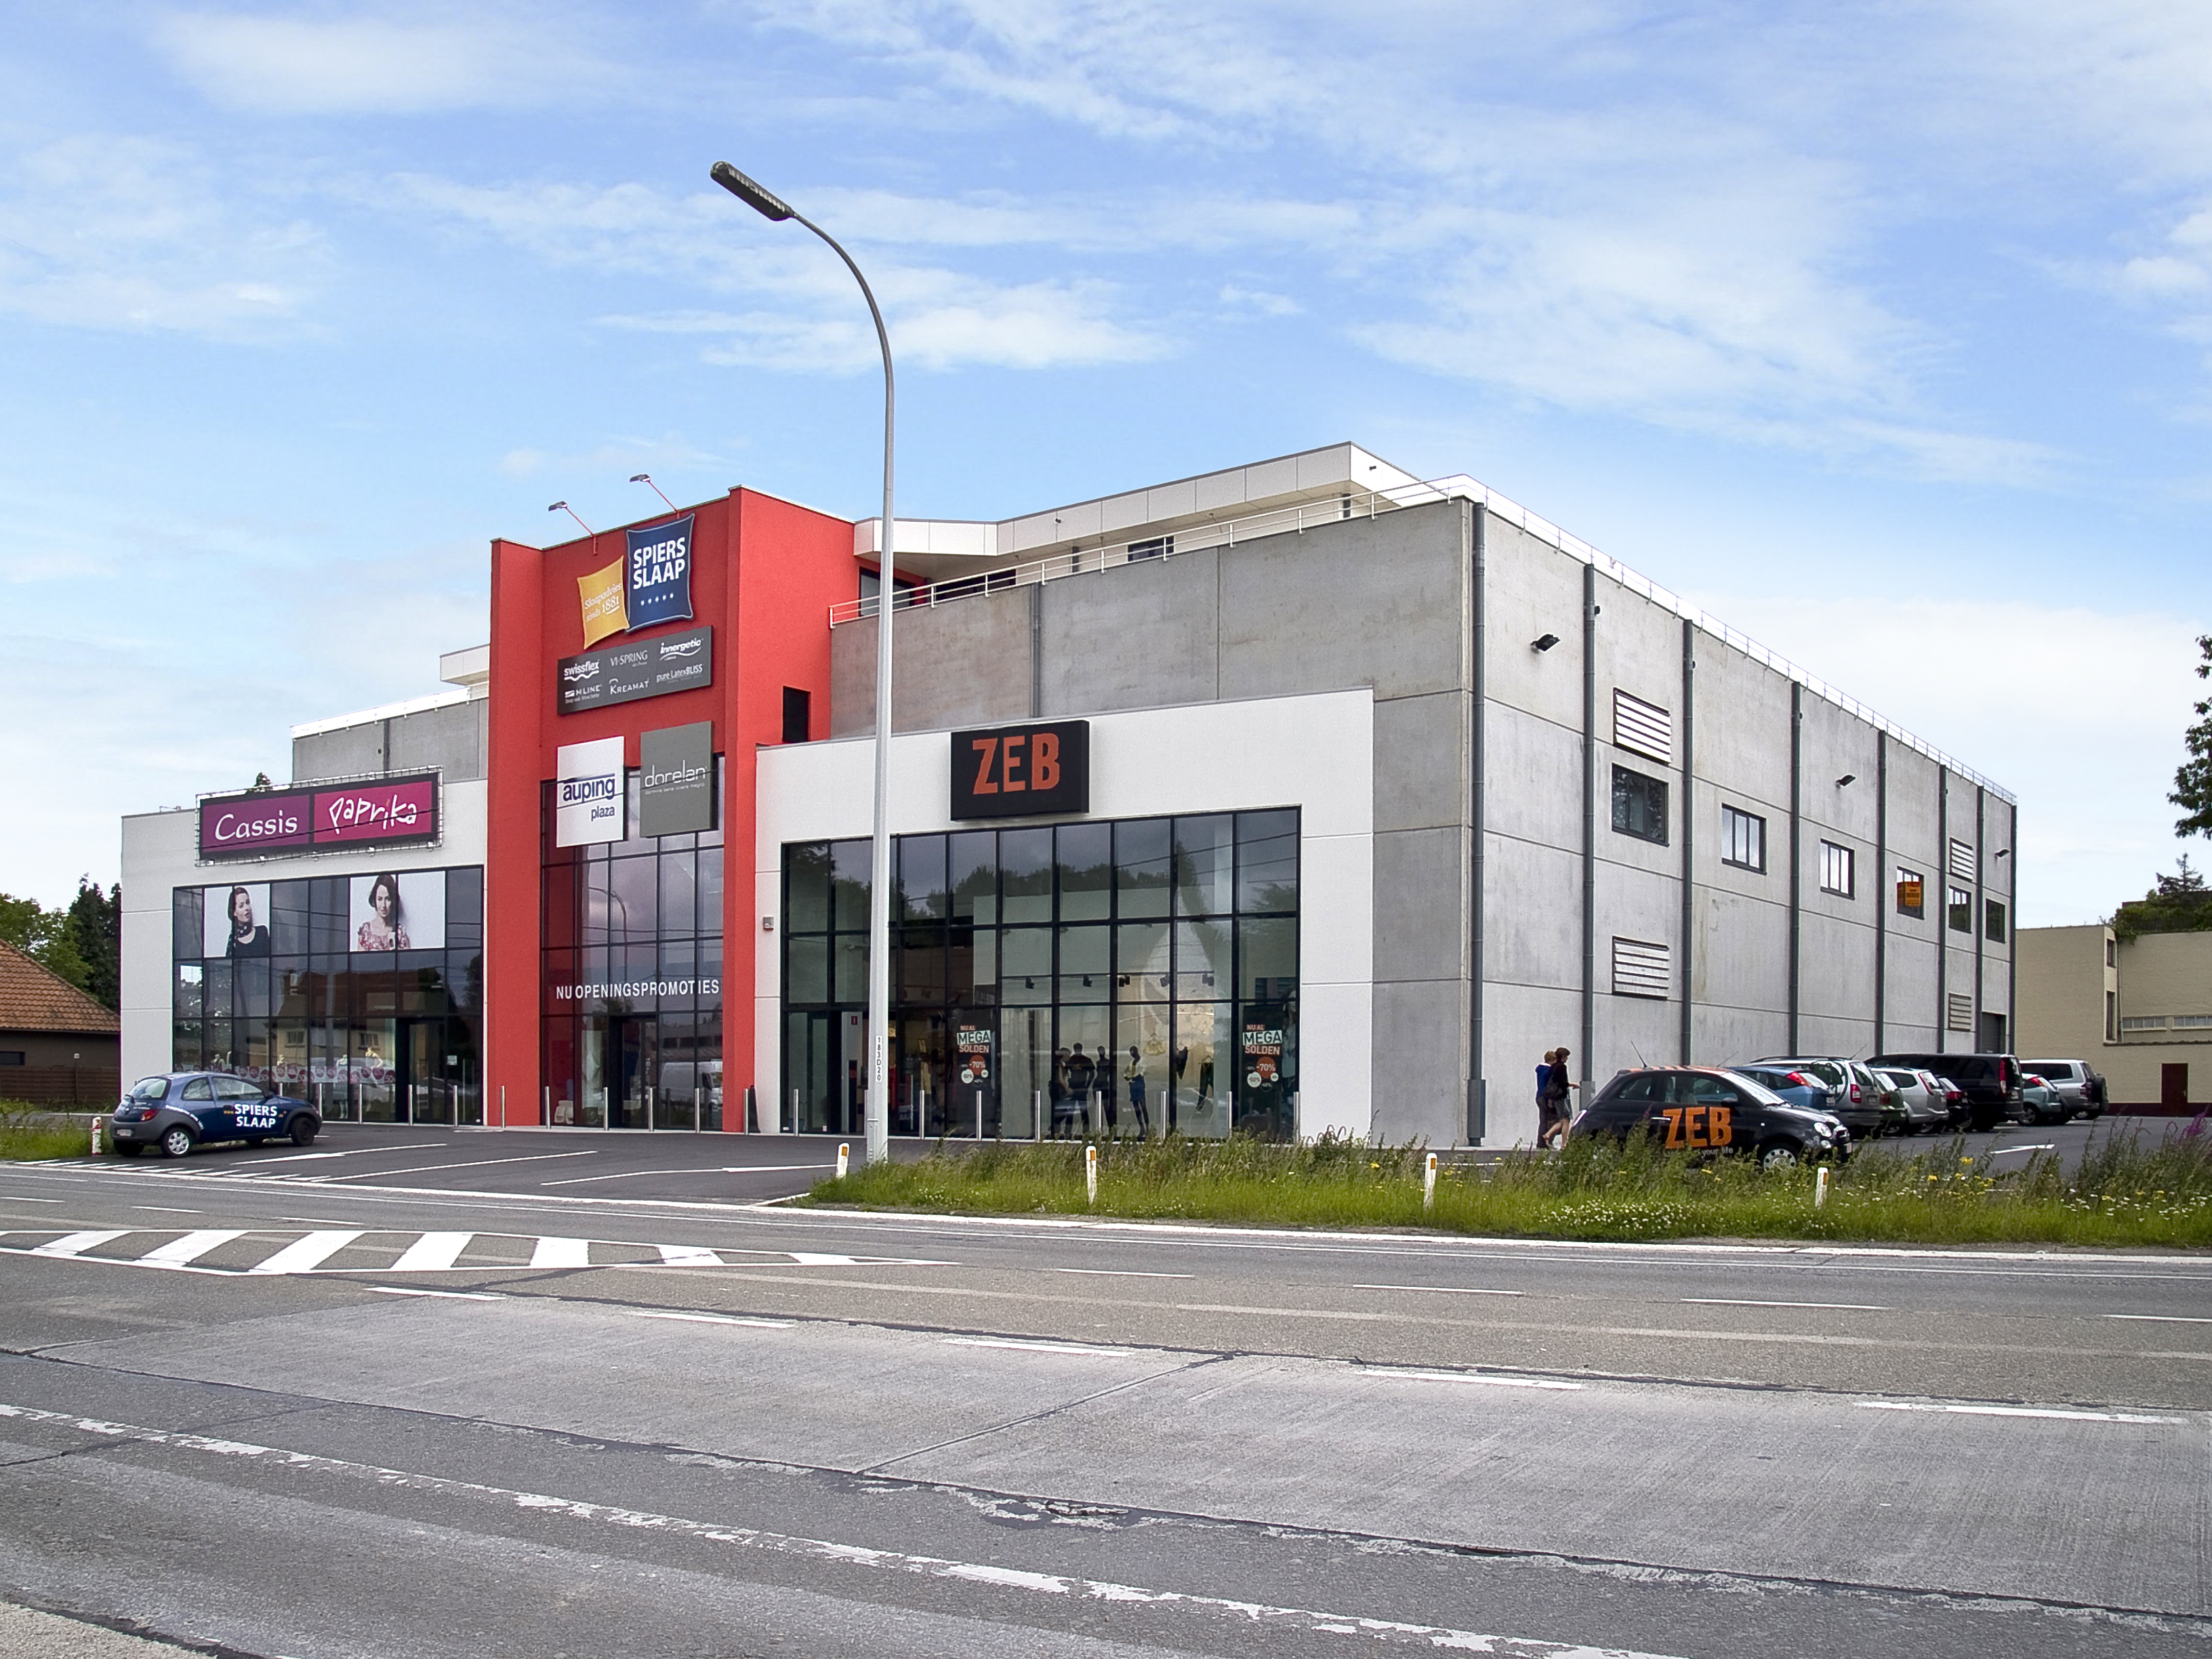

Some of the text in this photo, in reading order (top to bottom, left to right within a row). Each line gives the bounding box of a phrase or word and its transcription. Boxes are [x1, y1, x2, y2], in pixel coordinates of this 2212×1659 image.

[634, 537, 685, 569] SPIERS
[634, 558, 684, 590] SLAAP
[602, 596, 619, 613] 1881
[660, 638, 701, 654] innergetic
[564, 661, 599, 676] swissflex
[656, 673, 670, 683] pure
[583, 684, 600, 695] LINE
[972, 733, 1060, 794] ZEB
[645, 760, 705, 787] dorelan
[563, 778, 615, 803] auping
[591, 806, 615, 821] plaza
[215, 810, 298, 840] Cassis
[556, 979, 720, 1000] NU OPENINGSPROMOTIES
[958, 1031, 989, 1043] MEGA
[1244, 1031, 1281, 1045] MEGA
[959, 1044, 989, 1052] SOLDEN
[1245, 1046, 1280, 1055] SOLDEN
[234, 1104, 277, 1117] SPIERS
[236, 1116, 276, 1128] SLAAP
[1663, 1107, 1732, 1149] ZEB
[1702, 1149, 1718, 1159] your
